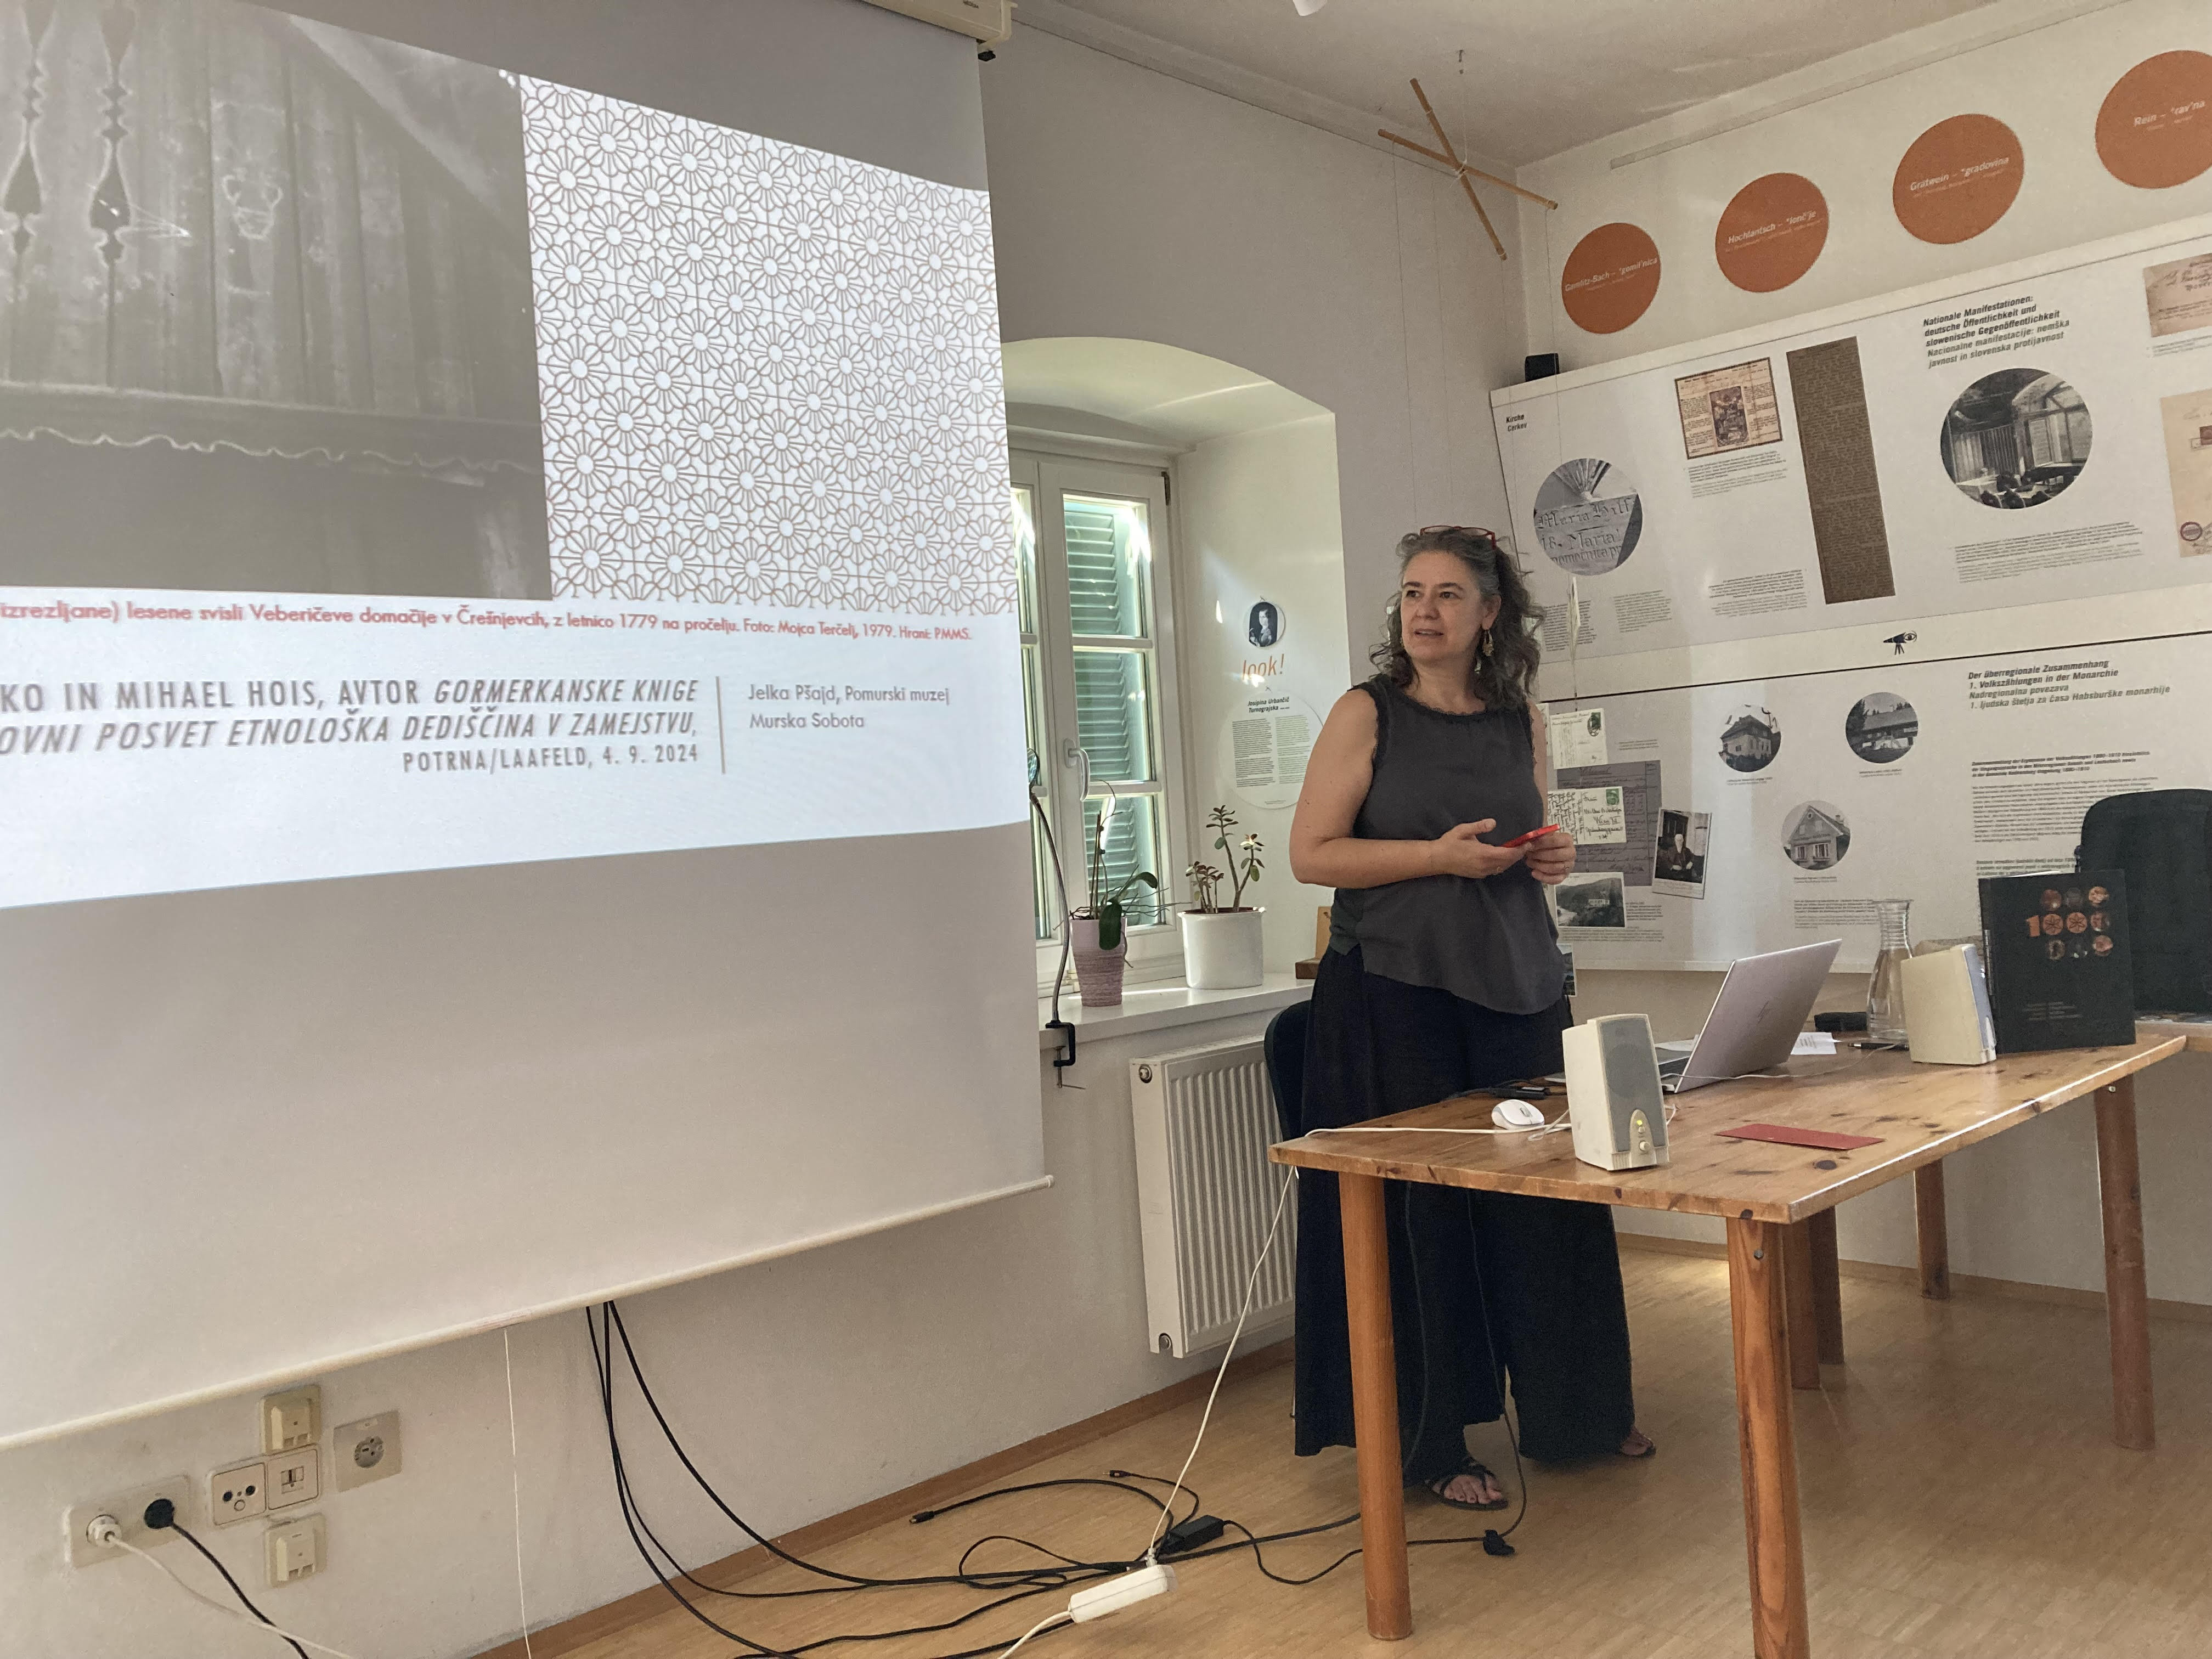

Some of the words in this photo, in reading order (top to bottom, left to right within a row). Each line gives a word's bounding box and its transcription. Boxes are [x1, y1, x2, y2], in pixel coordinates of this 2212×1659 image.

[1910, 174, 1949, 191] Gratwein
[1923, 312, 1961, 326] Nationale
[1964, 295, 2033, 317] Manifestationen:
[1925, 323, 1961, 337] deutsche
[1963, 311, 2018, 328] Öffentlichkeit
[2021, 304, 2036, 314] und
[1926, 330, 1976, 347] slowenische
[1978, 310, 2060, 335] Gegenöffentlichkeit
[1928, 342, 1973, 357] Nacionalne
[1975, 328, 2034, 347] manifestacije:
[2036, 319, 2069, 332] nemška
[1928, 356, 1957, 369] javnost
[1971, 345, 2011, 358] slovenska
[2013, 331, 2064, 351] protijavnost
[1506, 414, 1524, 423] Kirche
[1508, 422, 1527, 432] Cerkev
[127, 601, 192, 620] lesene
[199, 603, 244, 621] svisli
[250, 604, 354, 623] Veberičeve
[359, 607, 437, 628] domačije
[442, 613, 452, 624] v
[554, 616, 563, 627] z
[567, 612, 614, 628] letnico
[619, 613, 657, 629] 1779
[662, 619, 679, 630] na
[684, 618, 740, 634] pročelju.
[743, 618, 775, 633] Foto:
[778, 620, 815, 637] Mojca
[862, 623, 896, 638] 1979.
[1242, 653, 1284, 680] look!
[1968, 672, 1982, 680] Der
[1984, 666, 2041, 678] überregionale
[2042, 660, 2109, 673] Zusammenhang
[1979, 675, 2042, 689] Volkszählungen
[2056, 673, 2069, 682] der
[2073, 669, 2119, 680] Monarchie
[0, 684, 44, 712] KO
[63, 682, 98, 711] IN
[116, 681, 235, 709] MIHAEL
[248, 680, 324, 710] HOIS,
[338, 680, 418, 706] AVTOR
[435, 679, 625, 704] GORMERKANSKE
[632, 679, 698, 702] KNIGE
[748, 684, 789, 701] Jelka
[795, 684, 840, 705] Pšajd,
[845, 685, 905, 701] Pomurski
[910, 688, 950, 706] muzej
[1969, 688, 2028, 699] Nadregionalna
[2030, 684, 2069, 695] povezava
[1979, 699, 2009, 710] ljudska
[2012, 696, 2034, 707] štetja
[2072, 690, 2123, 701] Habsburške
[2126, 685, 2170, 697] monarhije
[0, 724, 82, 755] OVNI
[94, 720, 219, 752] POSVET
[226, 708, 390, 746] ETNOLOŠKA
[402, 706, 534, 740] DEDIŠČINA
[548, 712, 562, 736] V
[569, 712, 696, 737] ZAMEJSTVU,
[749, 712, 806, 729] Murska
[811, 713, 864, 728] Sobota
[403, 747, 592, 775] POTRNA/LAAFELD,
[602, 745, 619, 765] 4.
[629, 744, 646, 764] 9.
[655, 744, 697, 763] 2024
